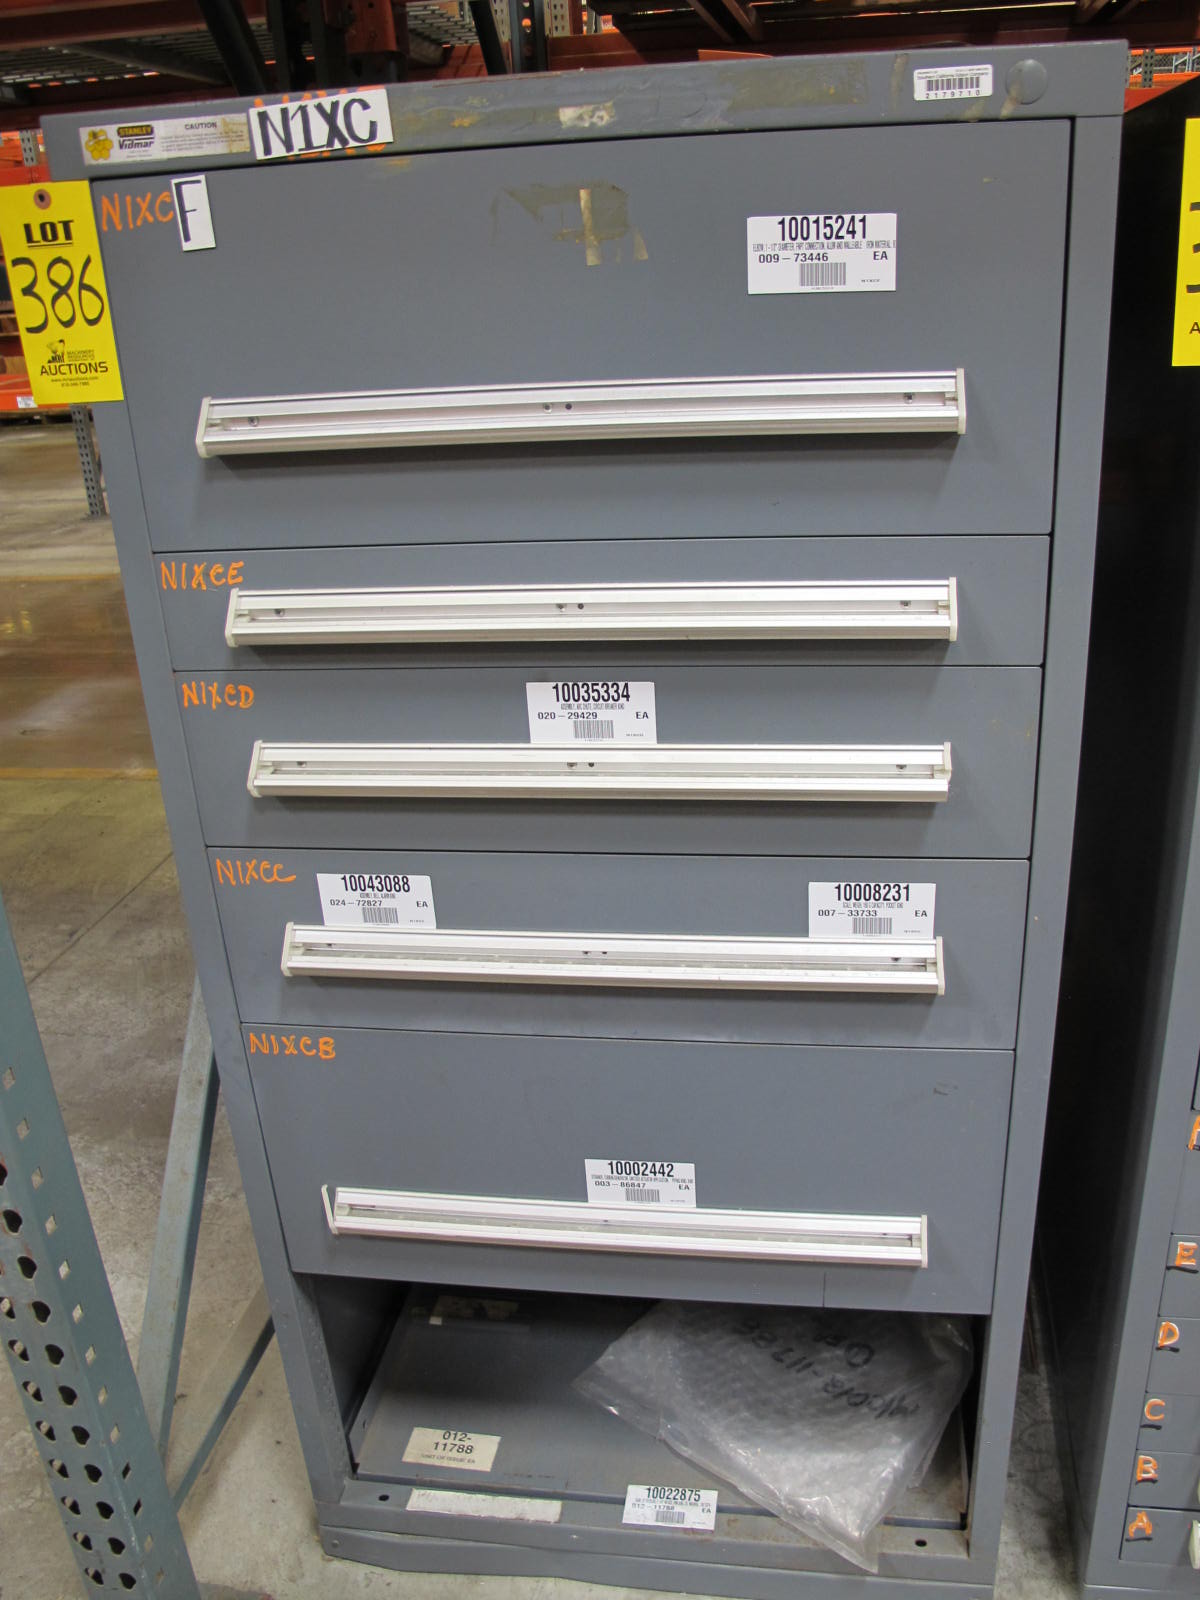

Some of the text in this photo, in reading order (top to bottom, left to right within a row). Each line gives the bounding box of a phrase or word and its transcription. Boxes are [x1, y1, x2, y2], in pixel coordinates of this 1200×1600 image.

[119, 126, 153, 136] STANLEY
[185, 121, 218, 131] CAUTION
[118, 139, 154, 150] Vidmar
[173, 179, 202, 243] F
[23, 219, 74, 244] LOT
[777, 214, 867, 241] 10015241
[873, 250, 888, 261] EA
[11, 254, 105, 334] 386
[40, 361, 109, 376] AUCTIONS
[552, 682, 631, 702] 10035334
[635, 711, 649, 720] EA
[340, 874, 411, 893] 10043088
[834, 883, 910, 902] 10008231
[416, 900, 429, 908] EA
[914, 909, 928, 918] EA
[608, 1160, 674, 1178] 10002442
[1174, 1241, 1198, 1266] E
[1158, 1320, 1180, 1348] D
[1144, 1398, 1166, 1421] C
[442, 1430, 472, 1443] 012-
[433, 1441, 474, 1455] 11788
[1136, 1454, 1159, 1482] B
[646, 1486, 701, 1502] 10022875
[1128, 1511, 1153, 1538] A
